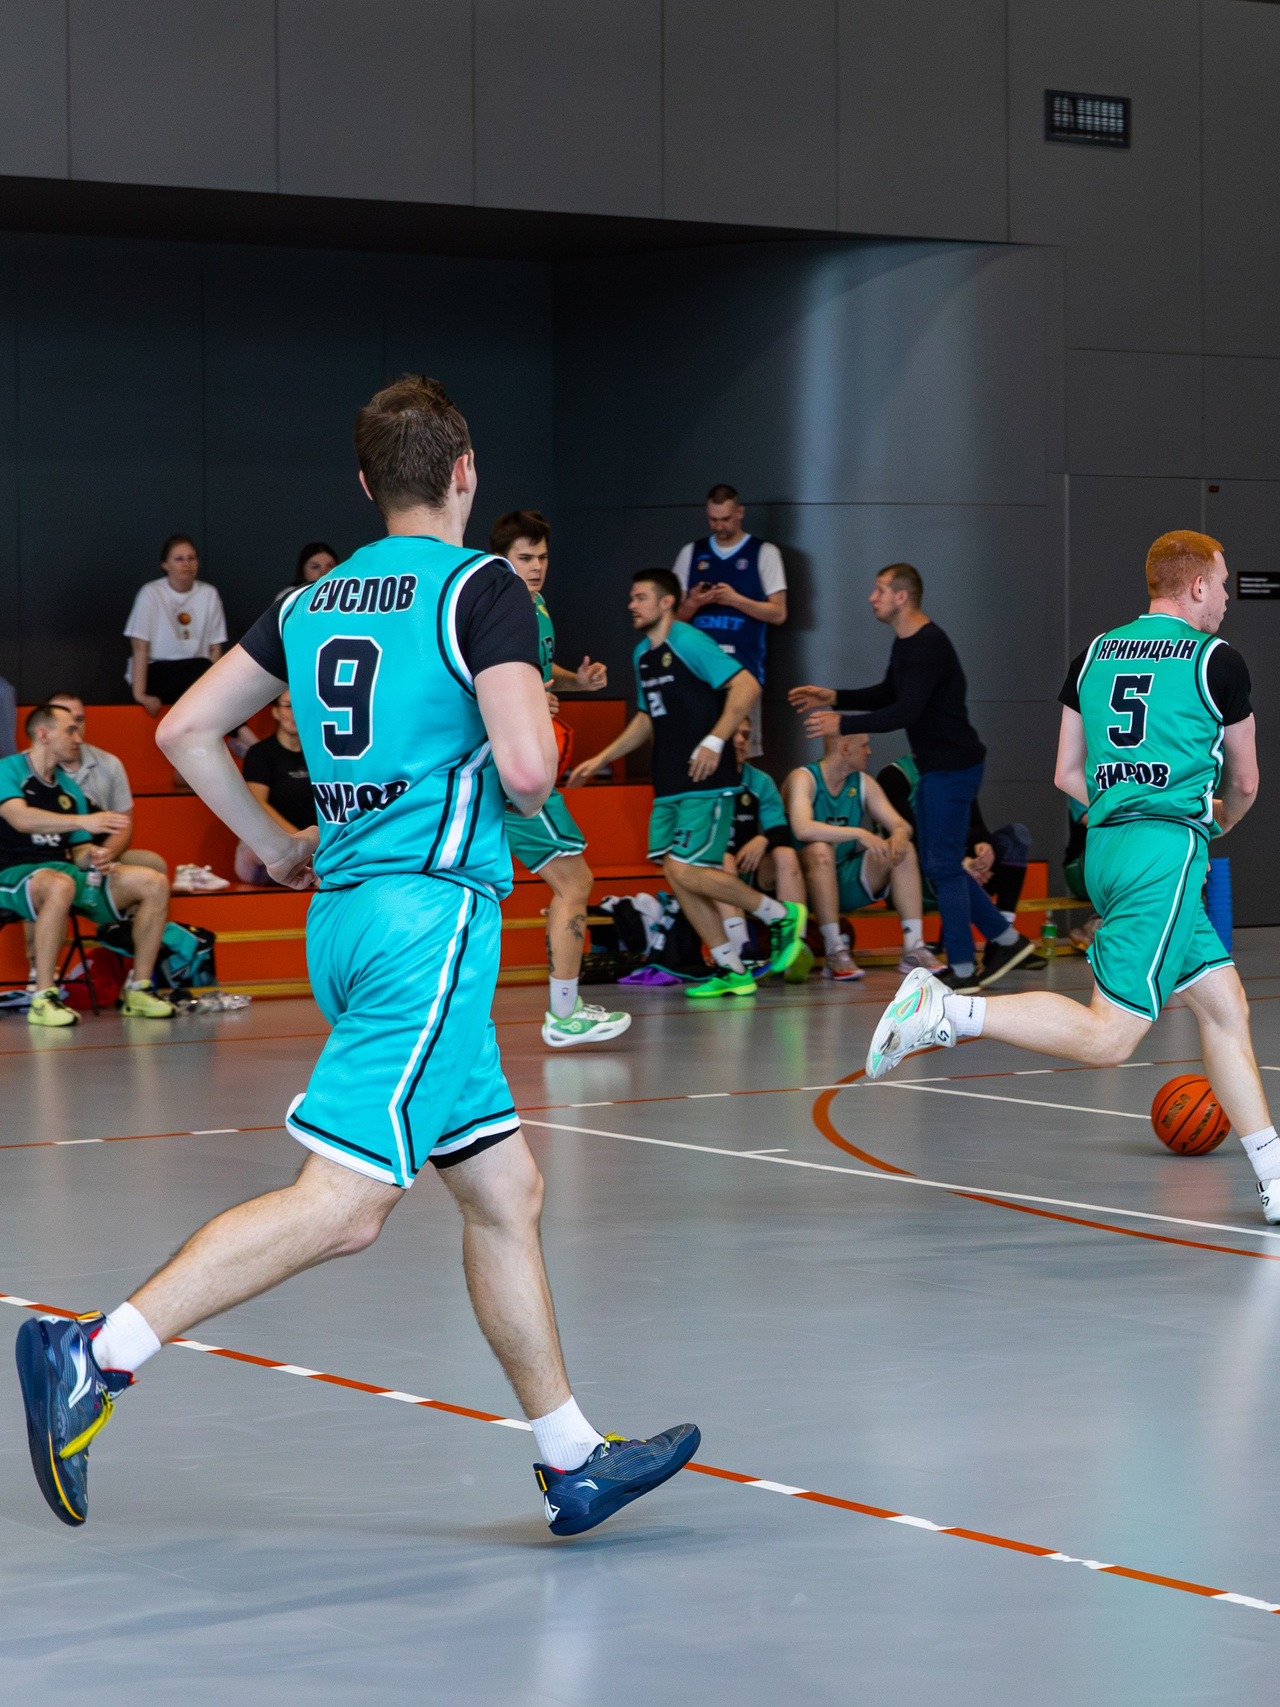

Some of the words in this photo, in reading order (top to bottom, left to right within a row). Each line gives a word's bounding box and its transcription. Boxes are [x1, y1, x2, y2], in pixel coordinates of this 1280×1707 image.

[308, 573, 418, 614] СУСЛОВ
[1096, 638, 1199, 663] КРИНИЦЫН
[315, 634, 383, 760] 9
[1107, 673, 1155, 749] 5
[1094, 761, 1171, 792] КИРОВ
